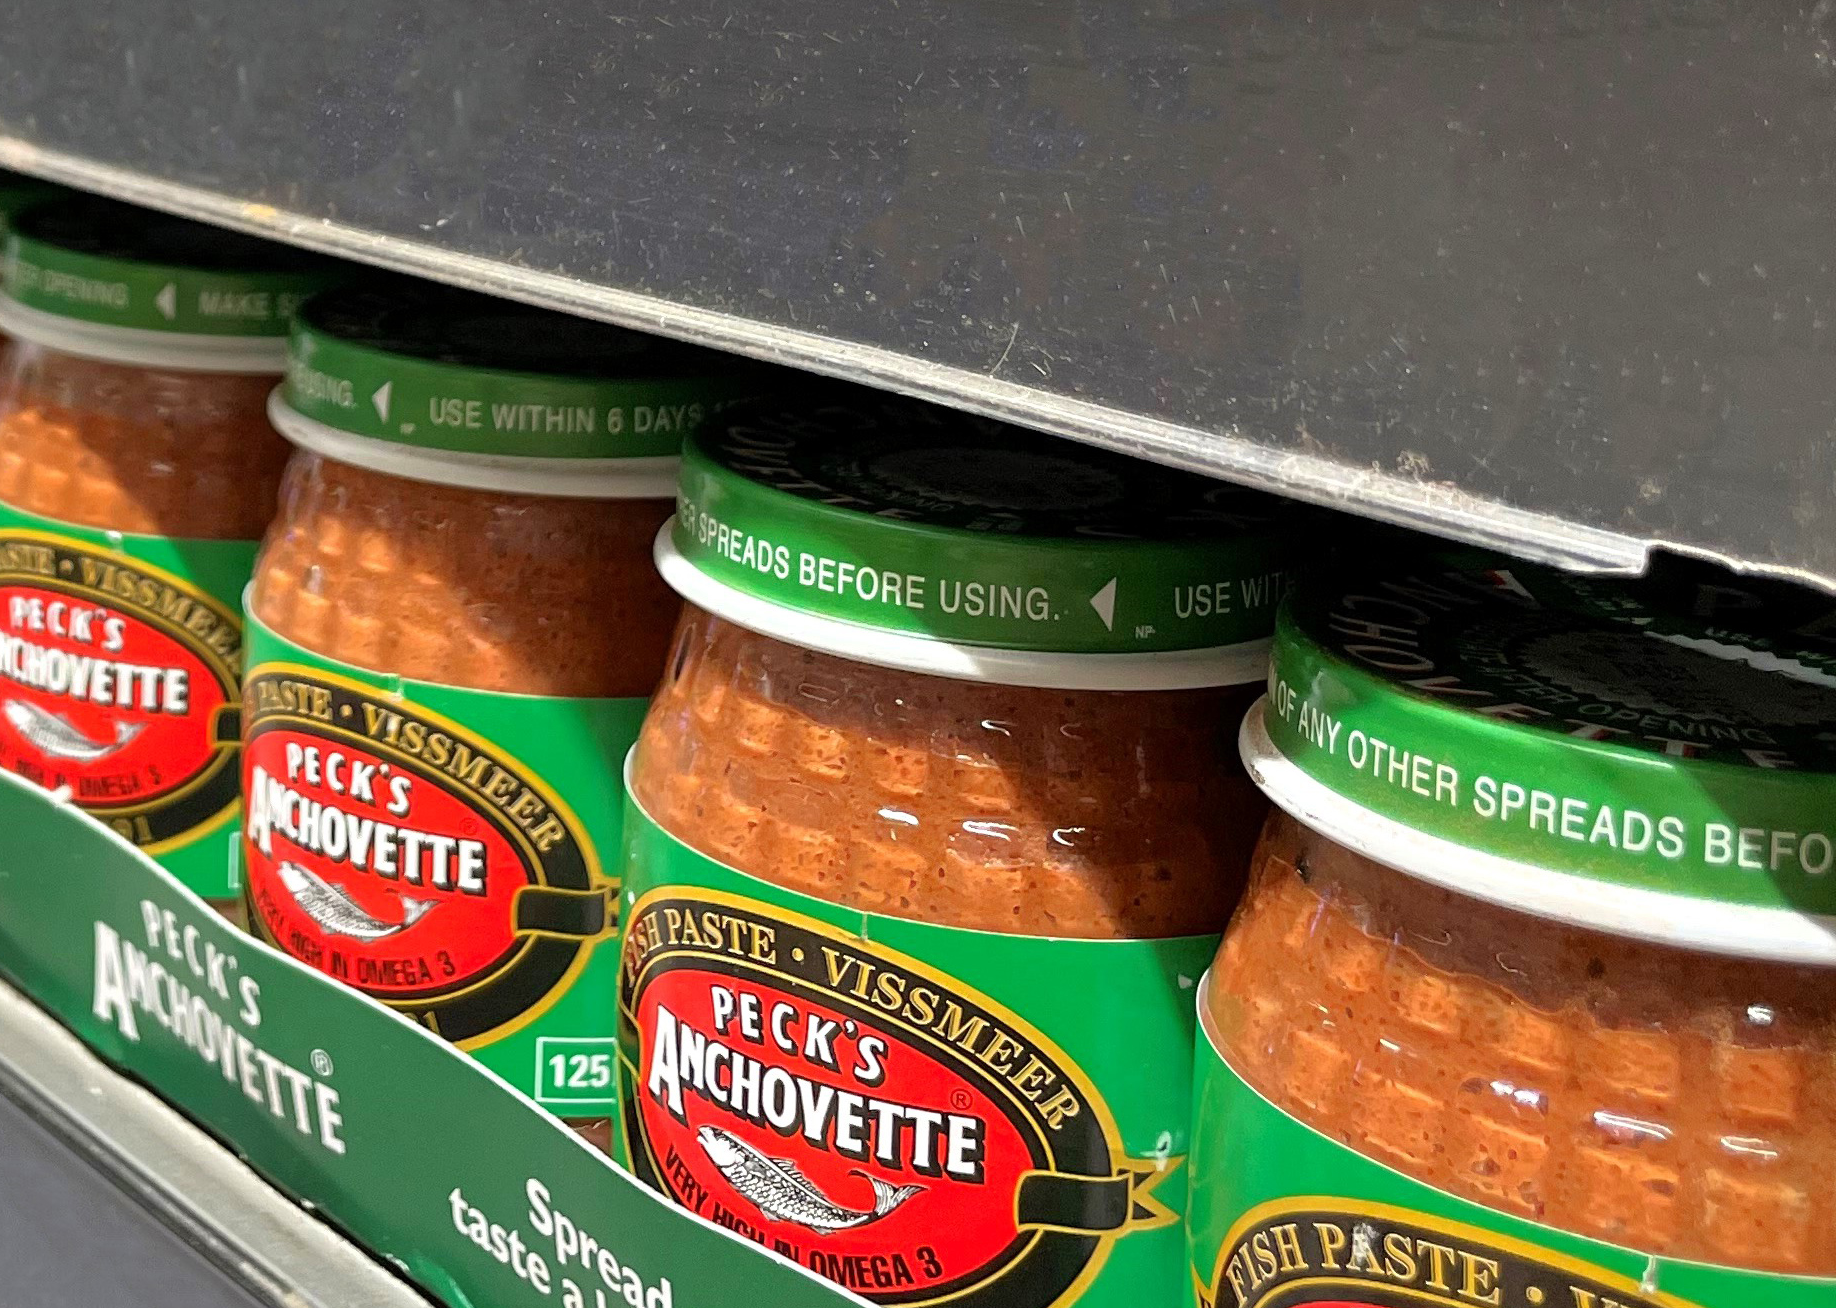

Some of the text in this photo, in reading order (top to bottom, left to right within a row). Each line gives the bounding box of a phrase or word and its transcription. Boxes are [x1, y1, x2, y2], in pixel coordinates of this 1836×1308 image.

[429, 397, 482, 428] USE
[492, 403, 595, 434] WITHIN
[607, 410, 624, 434] 6
[698, 512, 790, 579] SPREADS
[799, 552, 925, 610] BEFORE
[939, 580, 1060, 621] USING.
[1174, 582, 1231, 619] USE
[9, 595, 126, 652] PECK'S
[248, 764, 488, 897] ANCHOVETTE
[285, 741, 413, 818] PECK'S
[362, 701, 565, 853] VISSMEER
[1277, 679, 1297, 723] OF
[1297, 700, 1342, 754] ANY
[1347, 729, 1458, 807] OTHER
[1472, 774, 1685, 860] SPREADS
[1704, 823, 1833, 874] BEFO
[139, 899, 261, 1027] PECK'S
[357, 957, 434, 986] OMEGA
[436, 950, 456, 977] 3
[91, 919, 347, 1155] ANCHOVETTE
[548, 1055, 612, 1088] 125
[663, 907, 777, 965] PASTE
[822, 944, 1082, 1131] VISSMEER
[710, 983, 888, 1087] PECK'S
[648, 1003, 986, 1184] ANCHOVETTE
[448, 1187, 552, 1295] taste
[665, 1143, 709, 1215] VERY
[809, 1250, 915, 1289] OMEGA
[916, 1246, 943, 1280] 3
[1224, 1220, 1504, 1308] FISH PASTE
